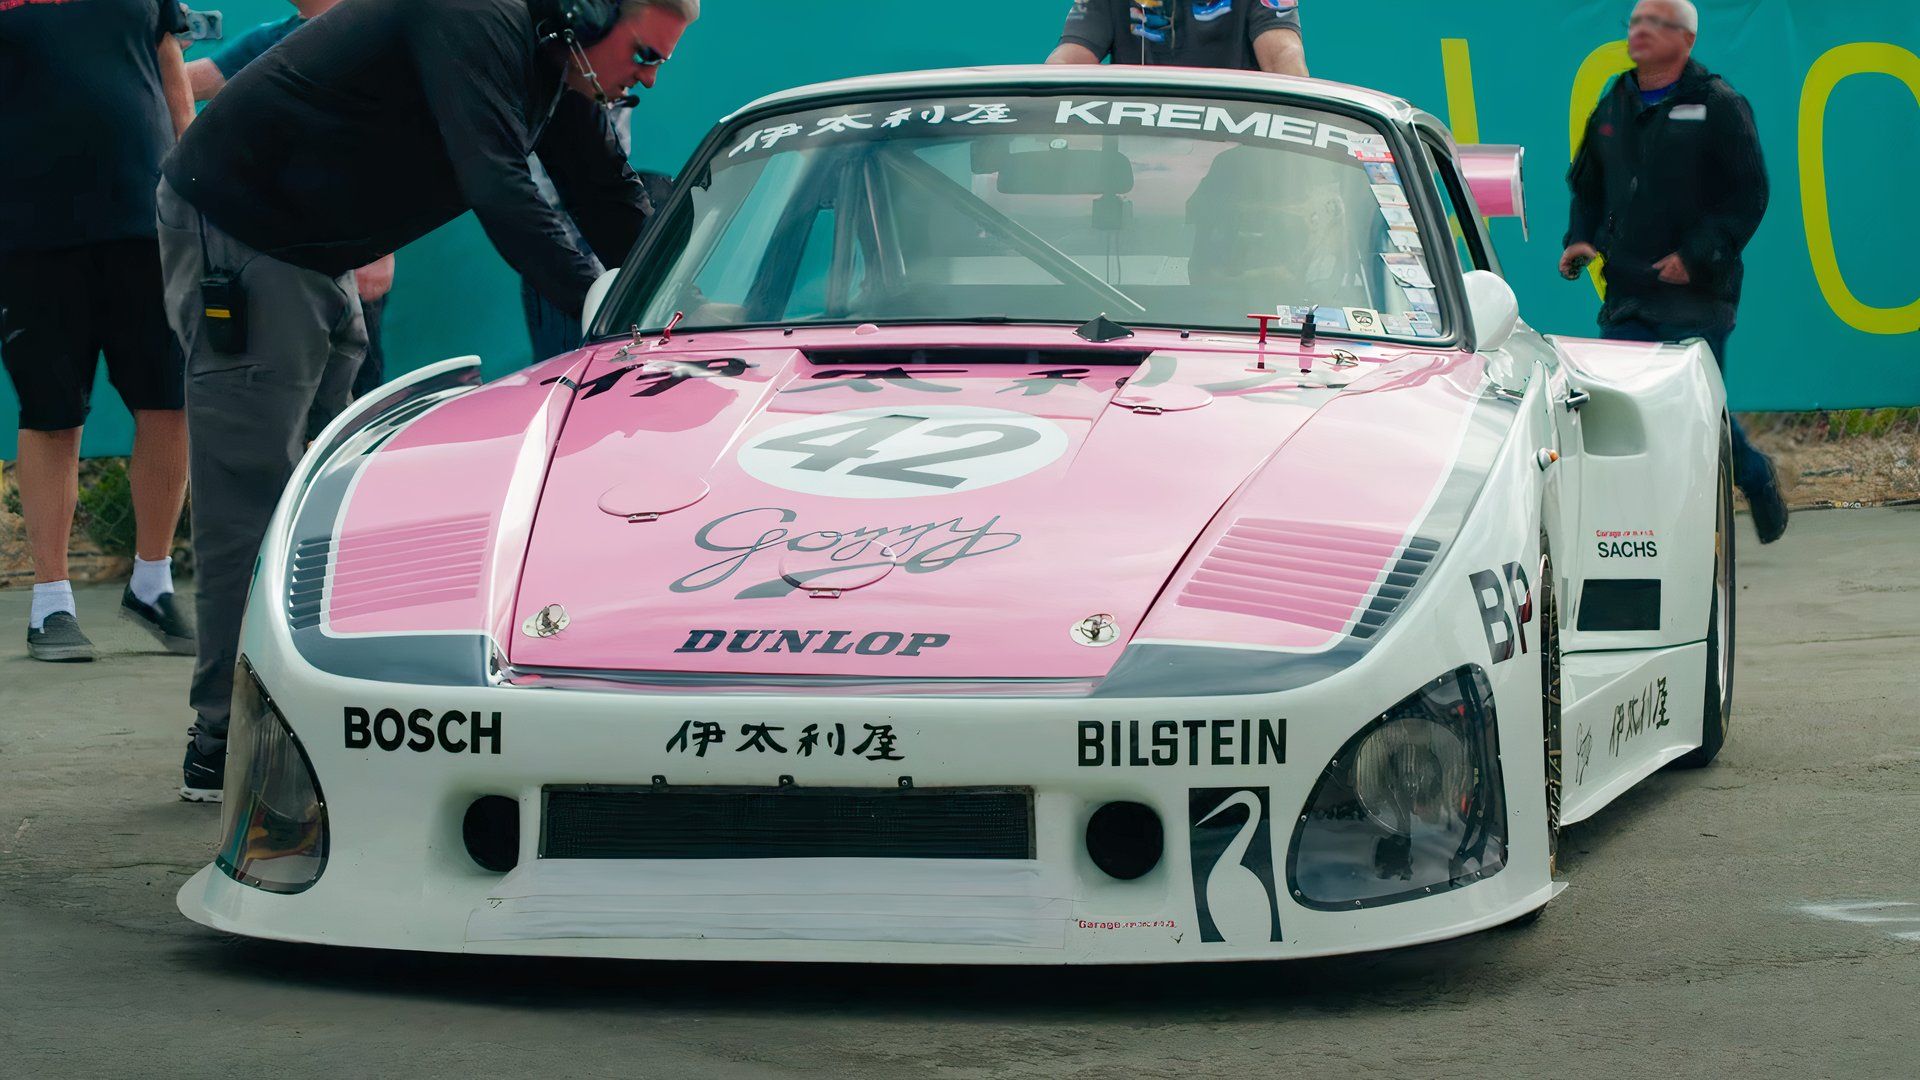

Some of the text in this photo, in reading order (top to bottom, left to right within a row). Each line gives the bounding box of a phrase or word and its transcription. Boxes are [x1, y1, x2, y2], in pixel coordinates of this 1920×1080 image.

[728, 103, 1018, 158] 伊太利屋
[1054, 100, 1359, 157] KREMER
[752, 414, 1042, 489] 42
[1597, 541, 1658, 558] SACHS
[1468, 560, 1533, 664] BP
[674, 629, 951, 657] DUNLOP
[343, 706, 502, 754] BOSCH
[666, 720, 905, 761] 伊太利屋
[1077, 718, 1288, 767] BILSTEIN
